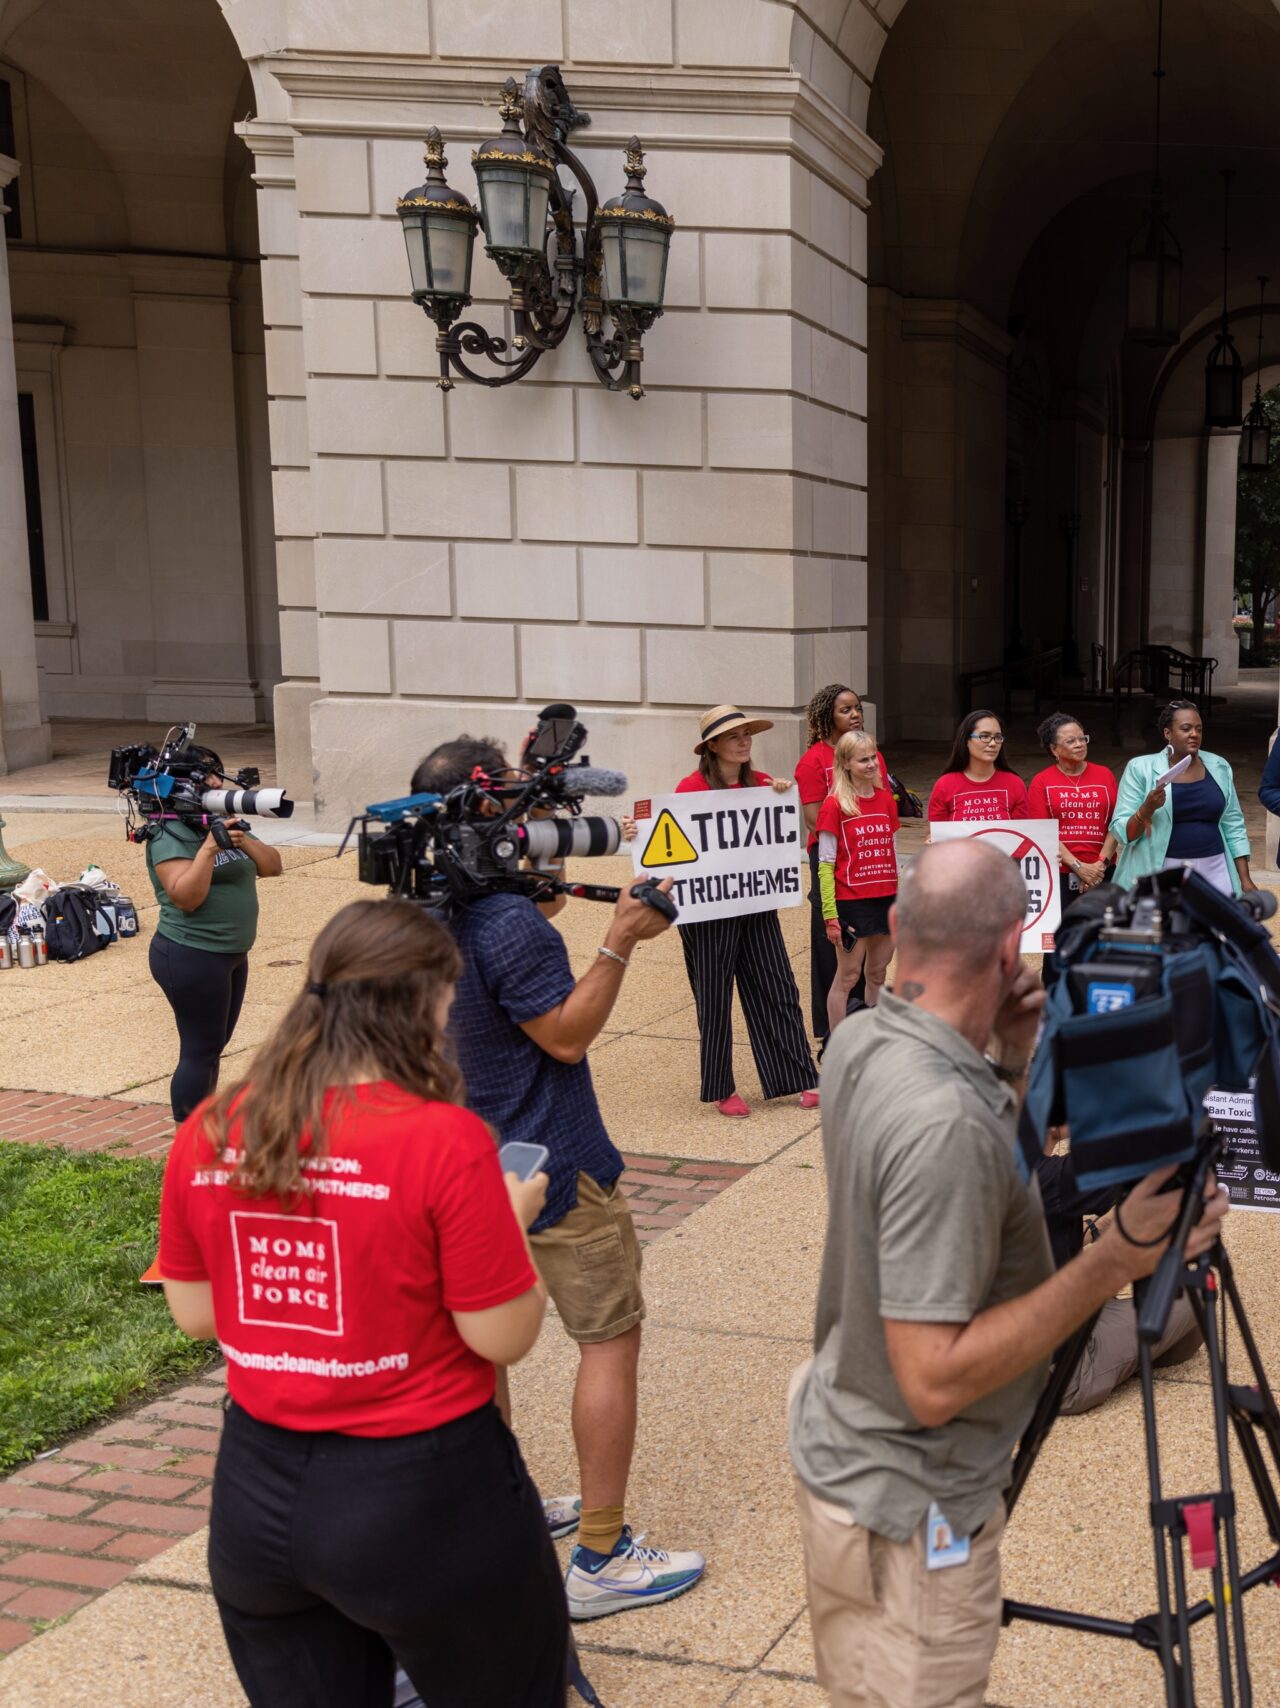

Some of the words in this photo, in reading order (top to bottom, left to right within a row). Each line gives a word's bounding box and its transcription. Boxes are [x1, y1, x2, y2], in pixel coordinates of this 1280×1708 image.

[964, 797, 998, 806] MOMS
[1060, 799, 1083, 808] clean
[1087, 800, 1100, 808] air
[963, 807, 985, 815] clean
[690, 805, 797, 852] TOXIC
[855, 824, 891, 835] MOMS
[857, 837, 879, 847] clean
[880, 836, 891, 845] air
[858, 849, 892, 859] FORCE
[673, 867, 799, 906] TROCHEMS
[1208, 1106, 1226, 1115] Ban
[1228, 1107, 1252, 1118] Toxic
[1223, 1125, 1238, 1133] have
[249, 1236, 325, 1260] MOMS
[250, 1257, 300, 1280] clean
[305, 1265, 327, 1283] air
[252, 1283, 329, 1309] FORCE
